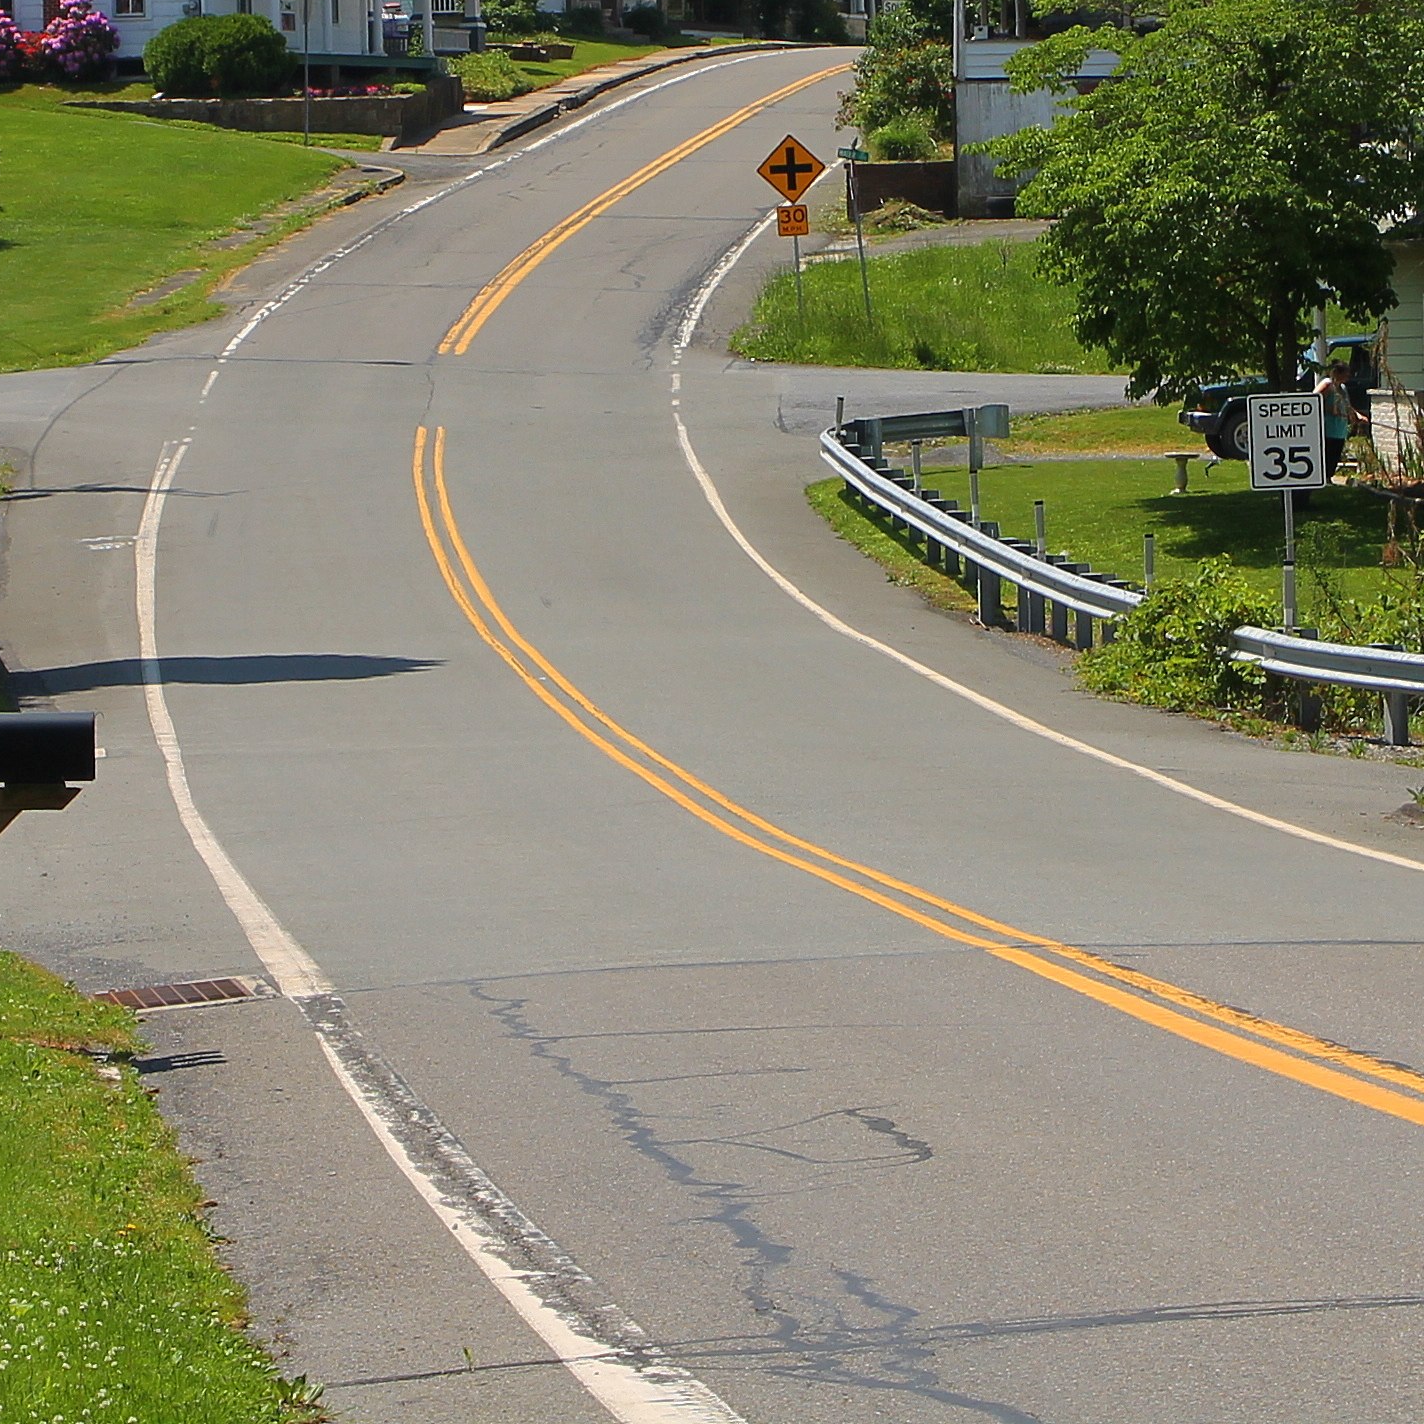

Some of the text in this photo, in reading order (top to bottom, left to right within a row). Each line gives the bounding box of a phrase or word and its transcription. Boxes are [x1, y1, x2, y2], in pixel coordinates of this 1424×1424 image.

[780, 208, 805, 224] 30
[1259, 402, 1312, 417] SPEED
[1266, 424, 1306, 439] LIMIT
[1262, 446, 1314, 480] 35
